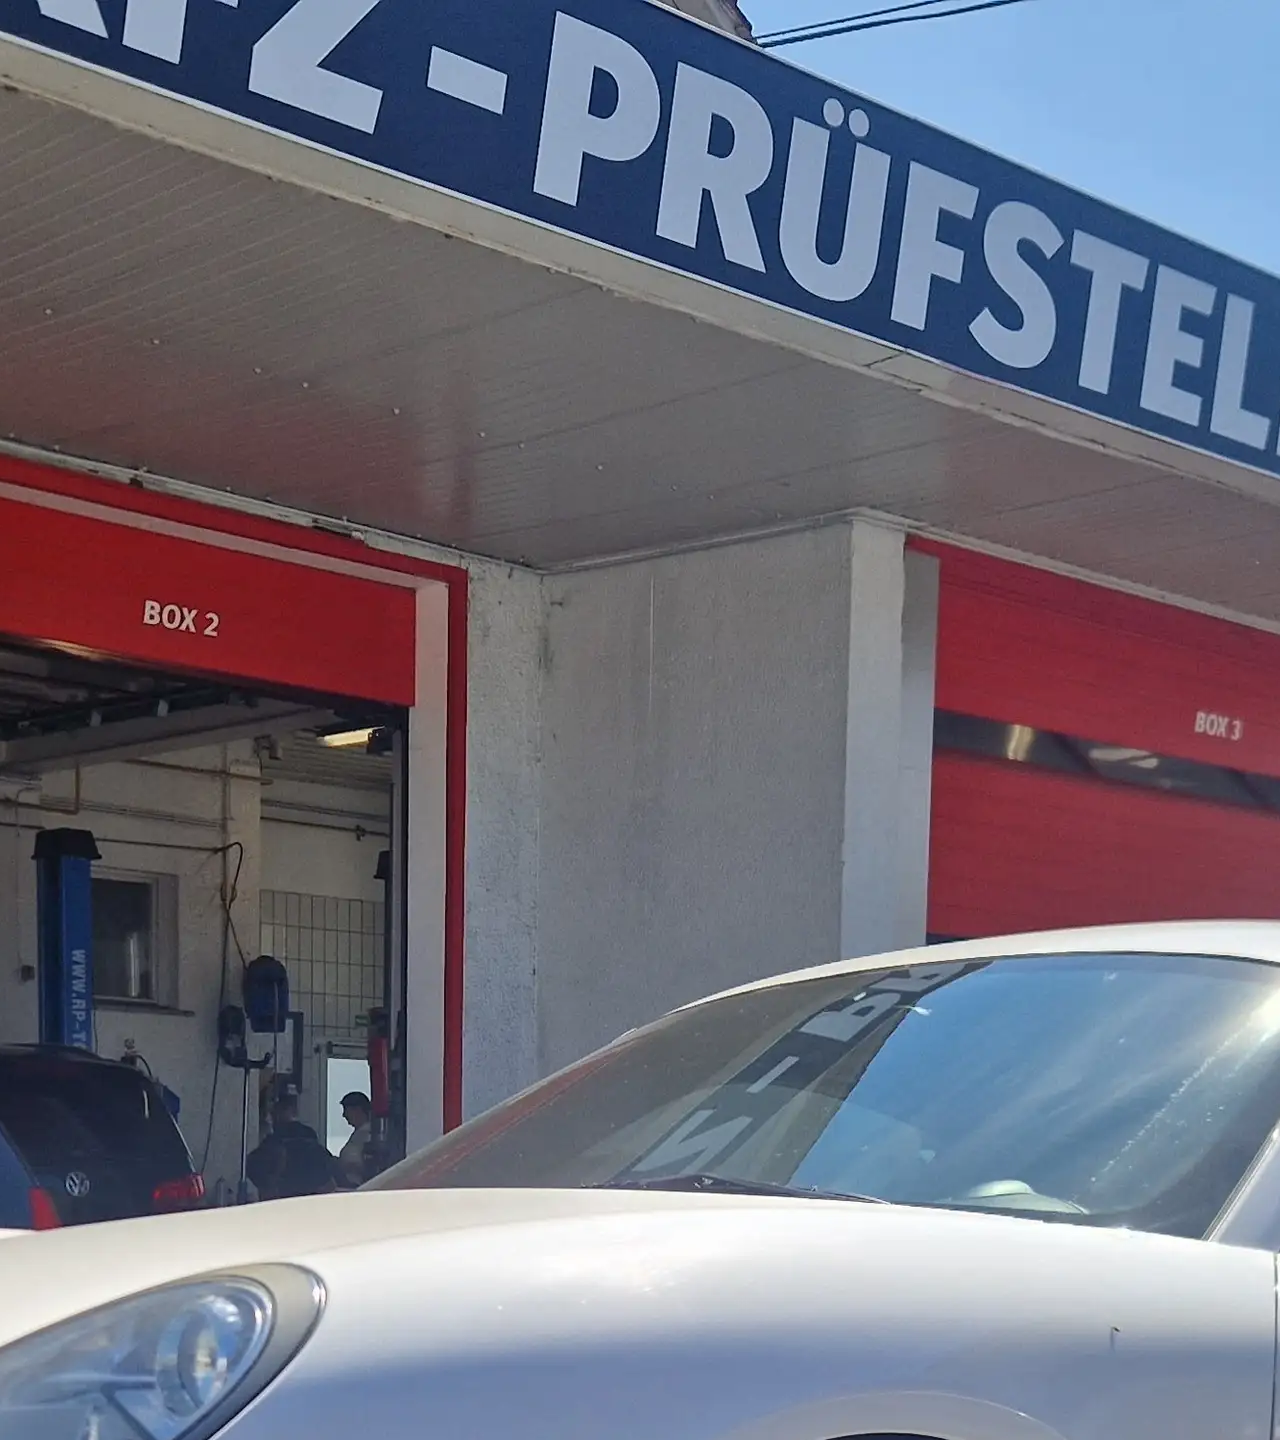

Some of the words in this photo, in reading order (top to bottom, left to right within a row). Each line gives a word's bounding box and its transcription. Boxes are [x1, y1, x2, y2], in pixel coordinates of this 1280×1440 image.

[143, 599, 199, 633] BOX
[203, 612, 220, 637] 2
[1194, 711, 1229, 738] BOX
[1231, 720, 1243, 741] 3
